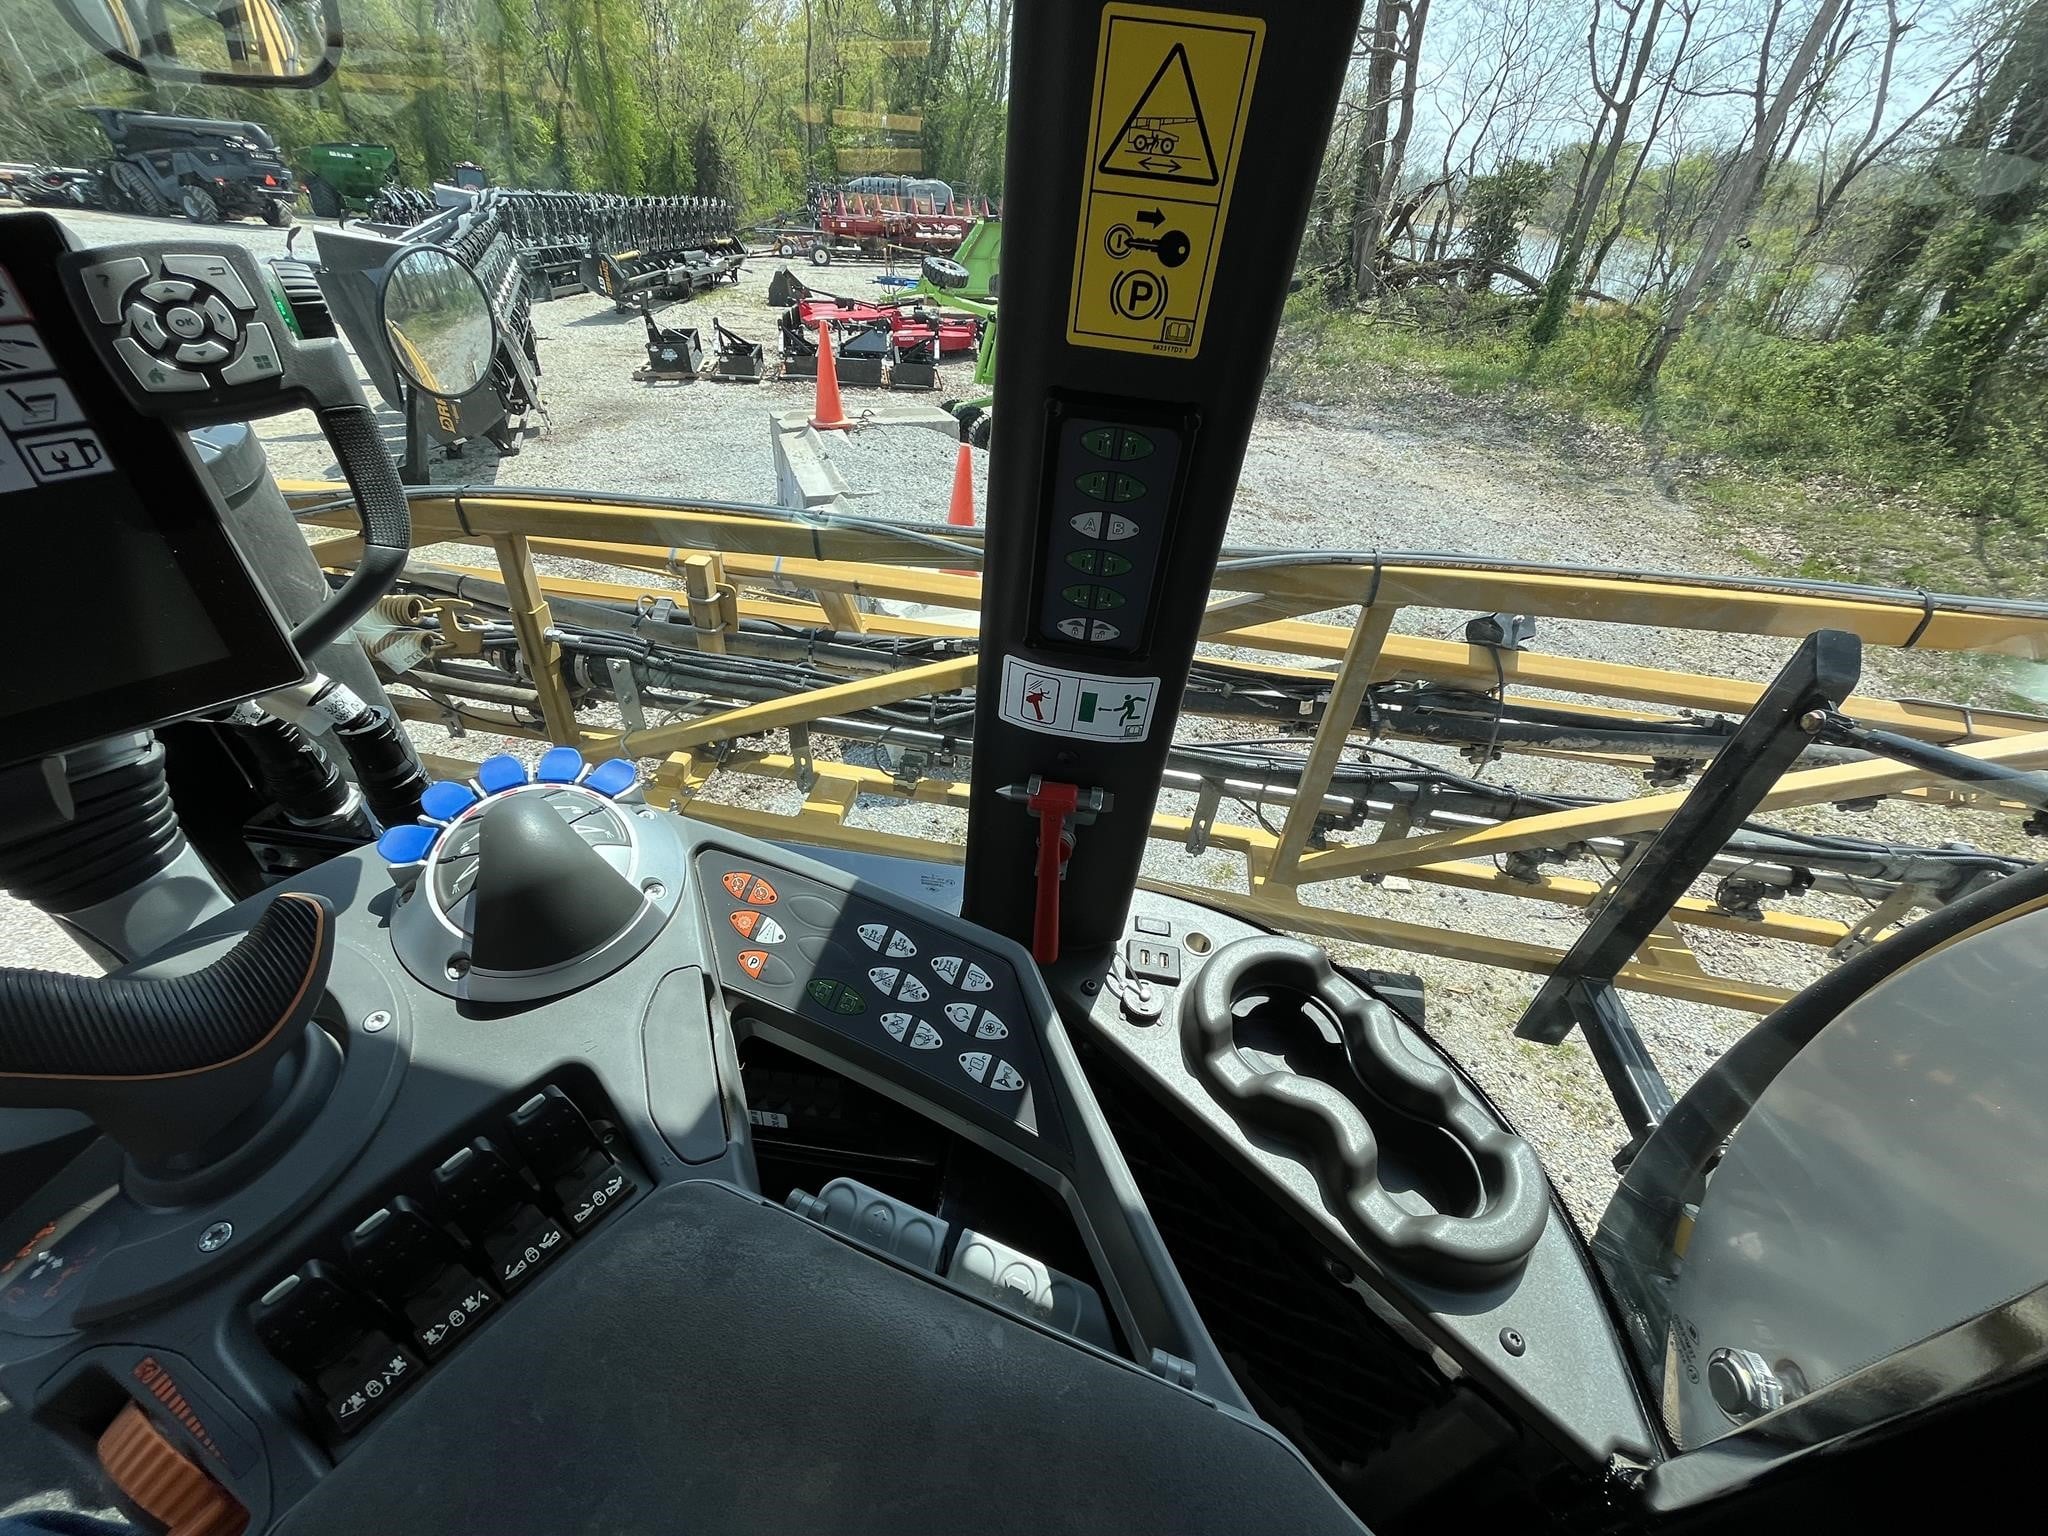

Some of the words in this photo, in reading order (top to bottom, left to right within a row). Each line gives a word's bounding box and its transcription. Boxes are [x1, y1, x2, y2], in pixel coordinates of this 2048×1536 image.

[1127, 279, 1154, 312] P
[175, 317, 195, 327] OK
[1083, 517, 1097, 532] A
[1113, 521, 1126, 535] B
[749, 957, 759, 967] P
